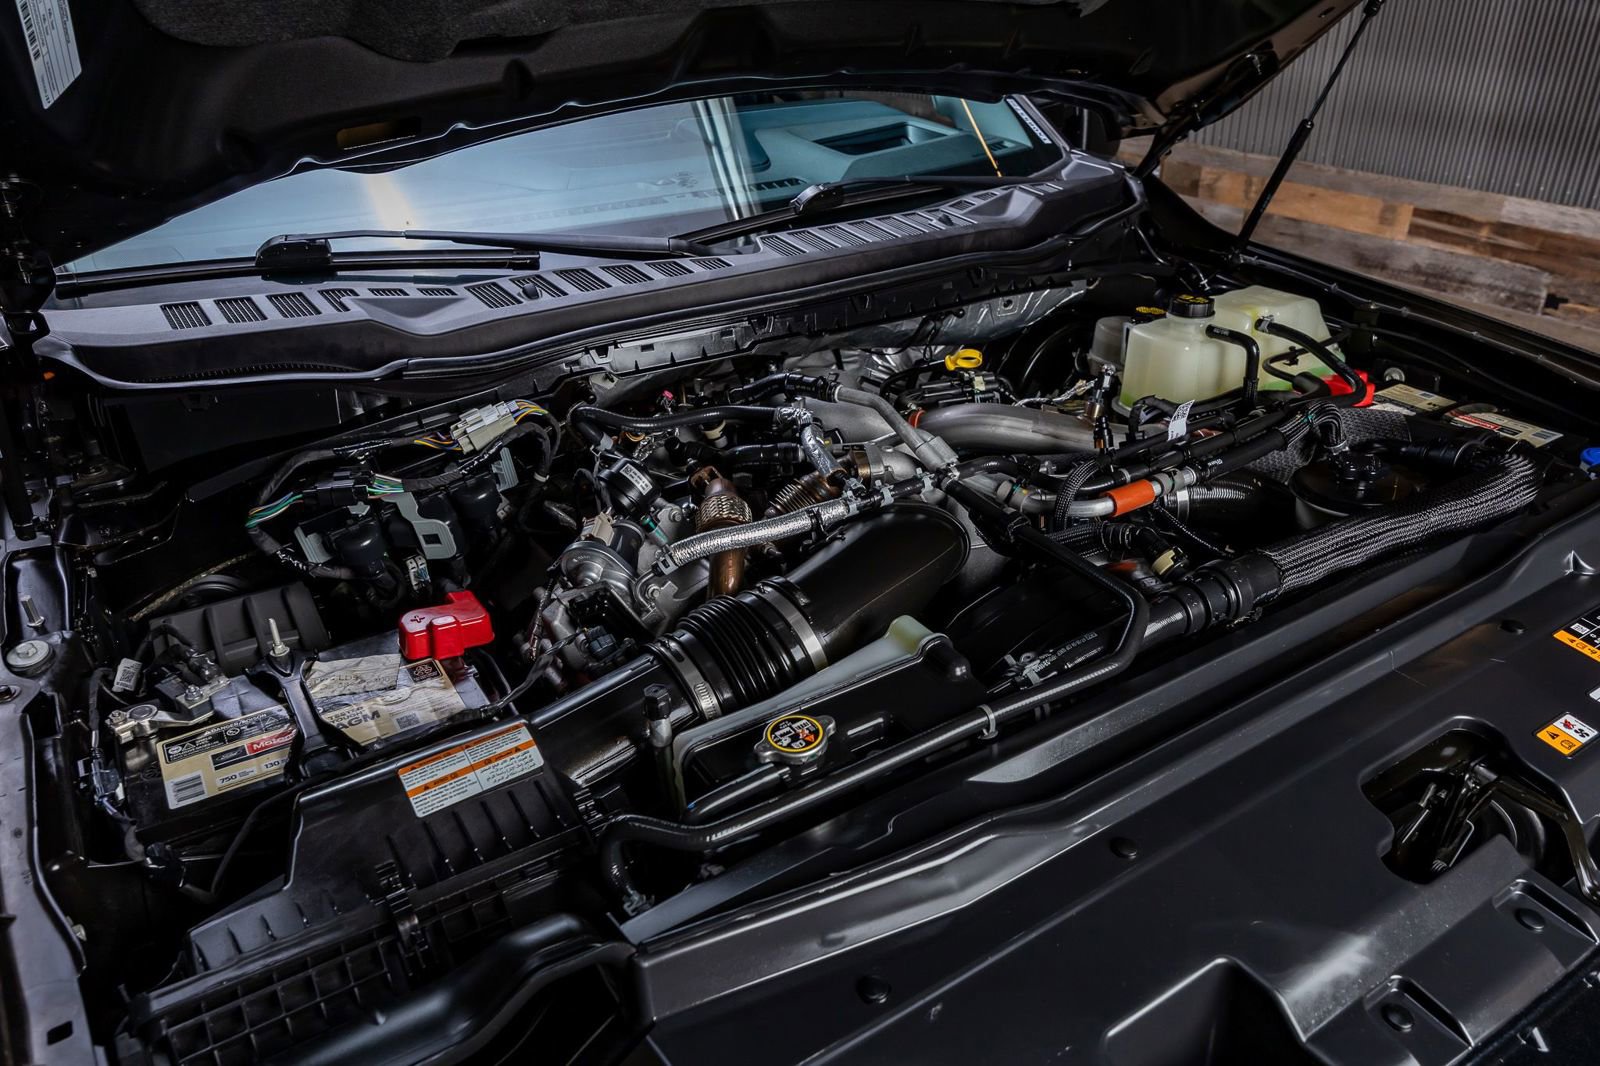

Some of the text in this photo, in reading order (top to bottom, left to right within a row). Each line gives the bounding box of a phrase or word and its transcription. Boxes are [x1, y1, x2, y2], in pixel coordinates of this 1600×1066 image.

[336, 710, 380, 730] AGM
[264, 760, 280, 769] 130
[220, 774, 237, 784] 750
